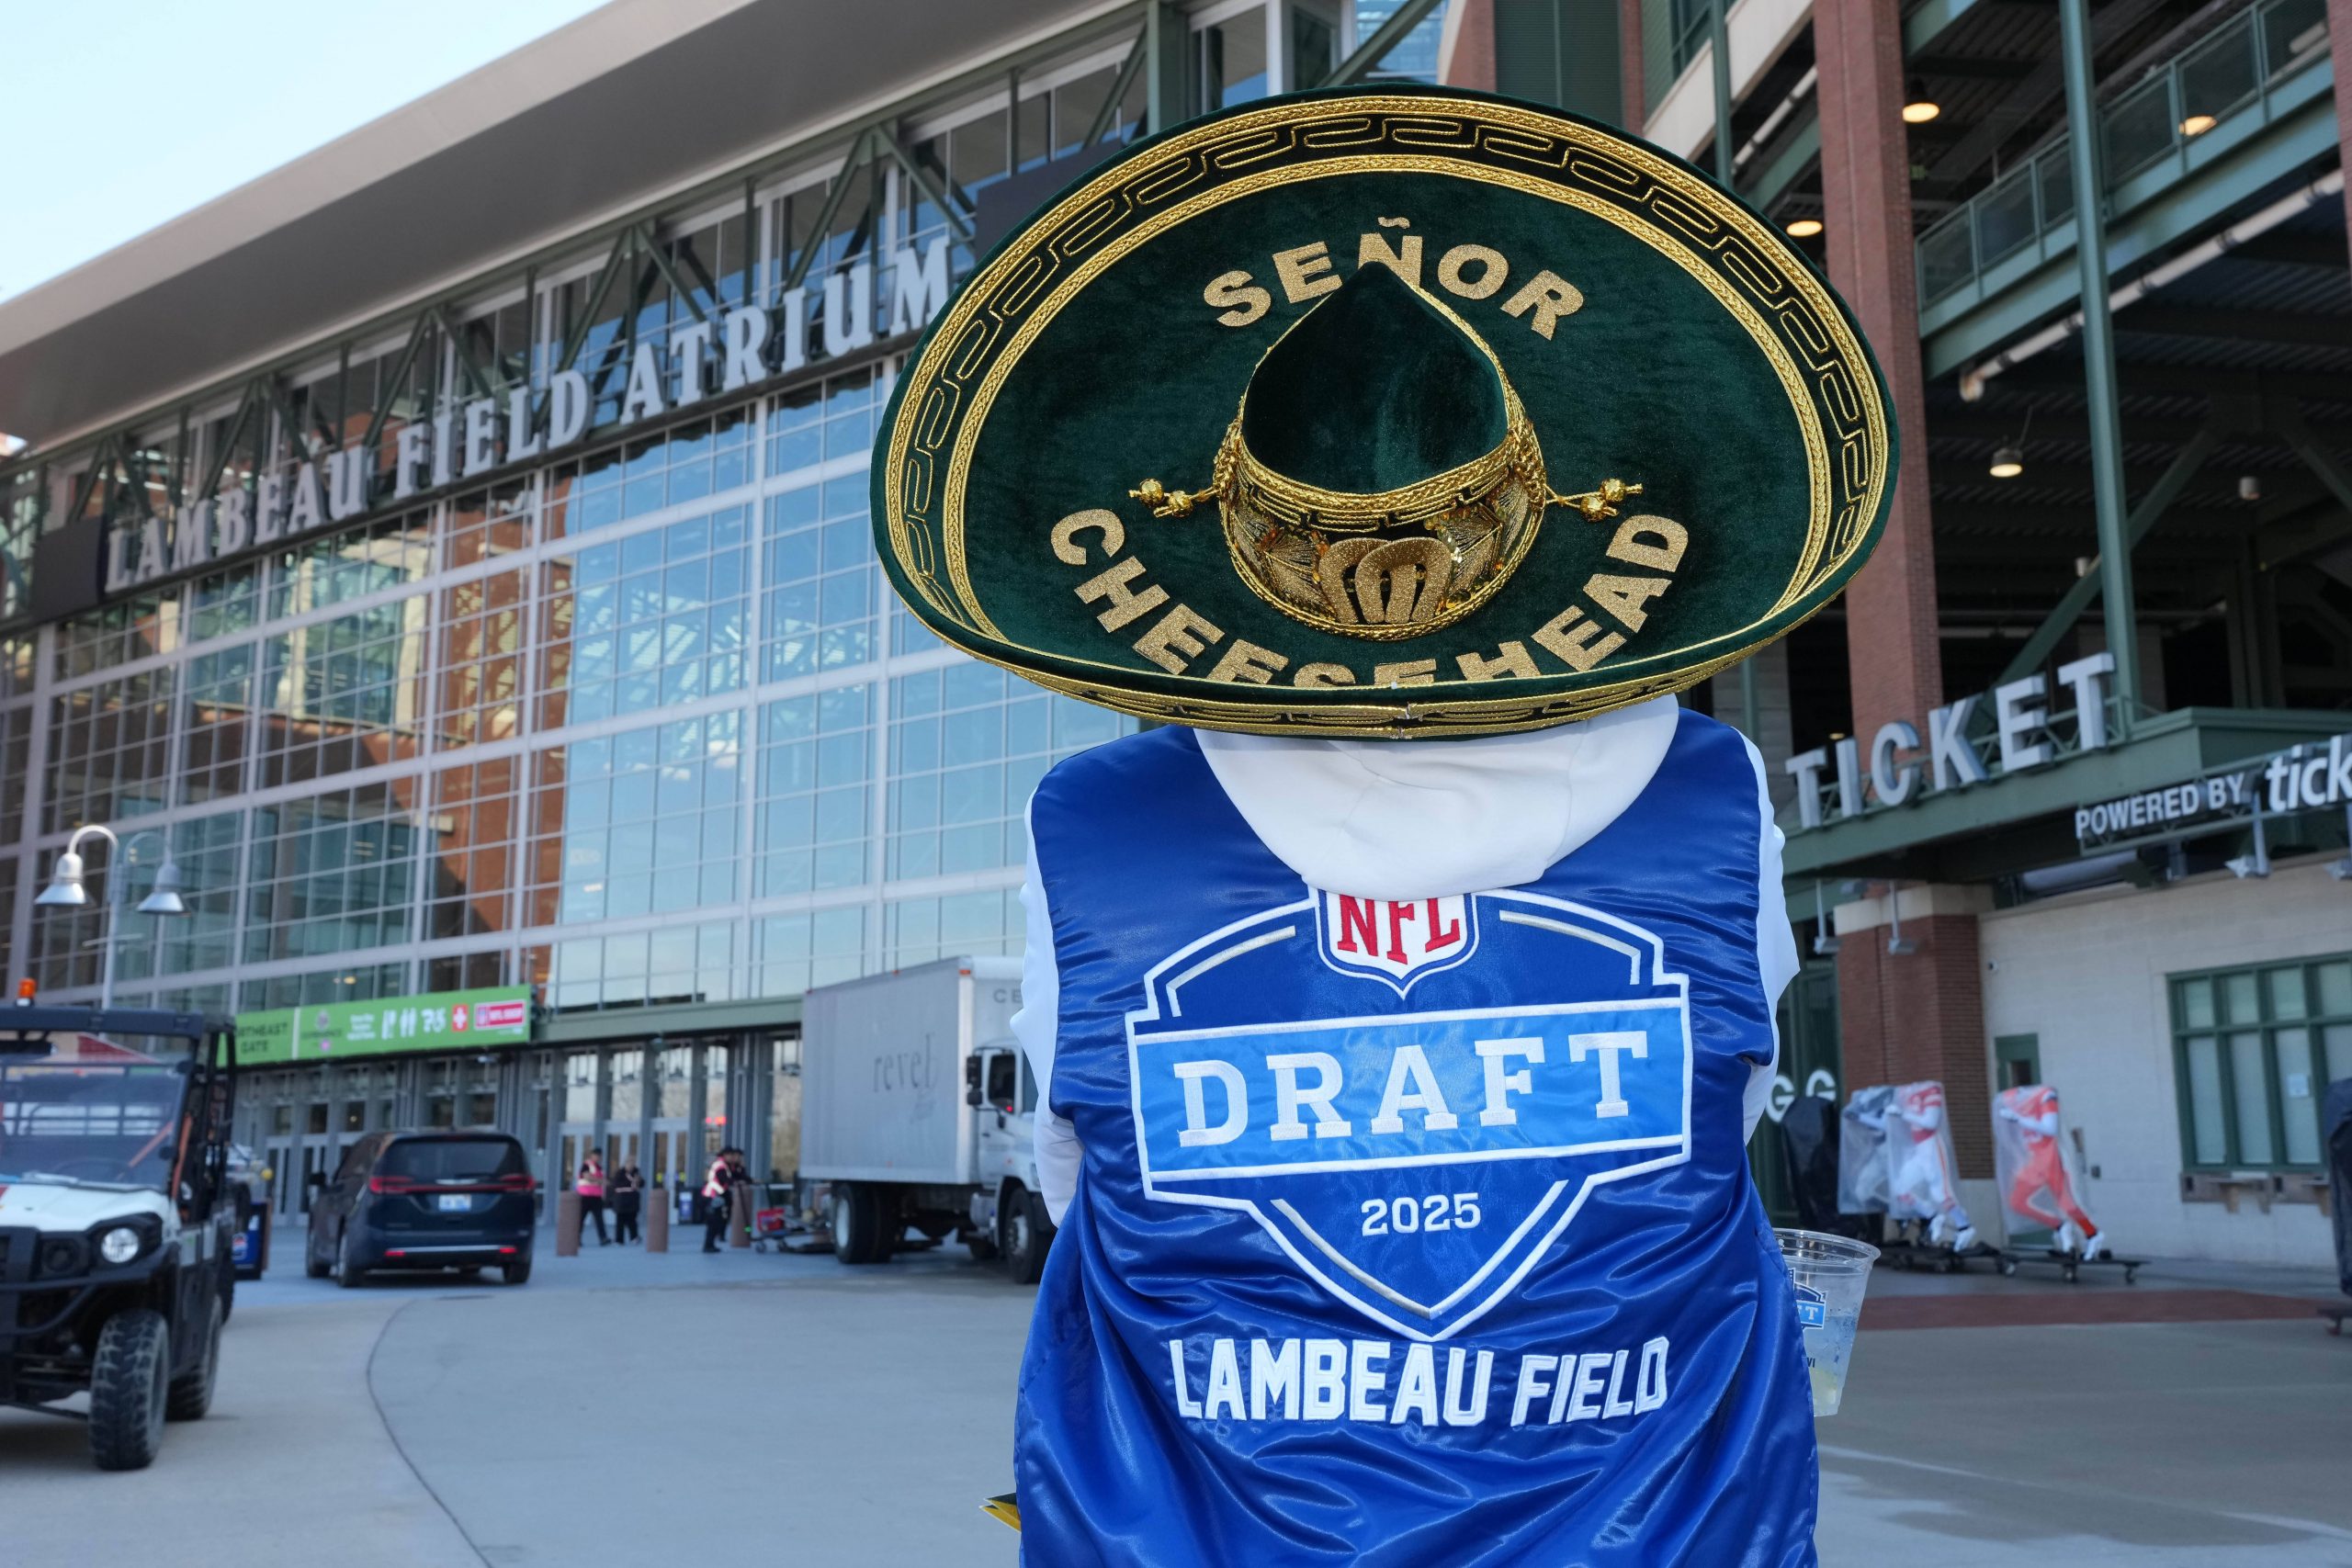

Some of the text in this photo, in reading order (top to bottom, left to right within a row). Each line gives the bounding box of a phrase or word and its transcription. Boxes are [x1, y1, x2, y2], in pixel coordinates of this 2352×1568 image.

[1204, 217, 1584, 341] SEÑOR
[105, 235, 952, 592] LAMBEAU FIELD ATRIUM
[1785, 652, 2114, 828] TICKET
[2075, 735, 2352, 839] POWERED BY tick
[1338, 894, 1461, 964] NFL
[1173, 1031, 1648, 1147] DRAFT
[1361, 1193, 1482, 1236] 2025
[1169, 1336, 1669, 1427] LAMBEAU FIELD
